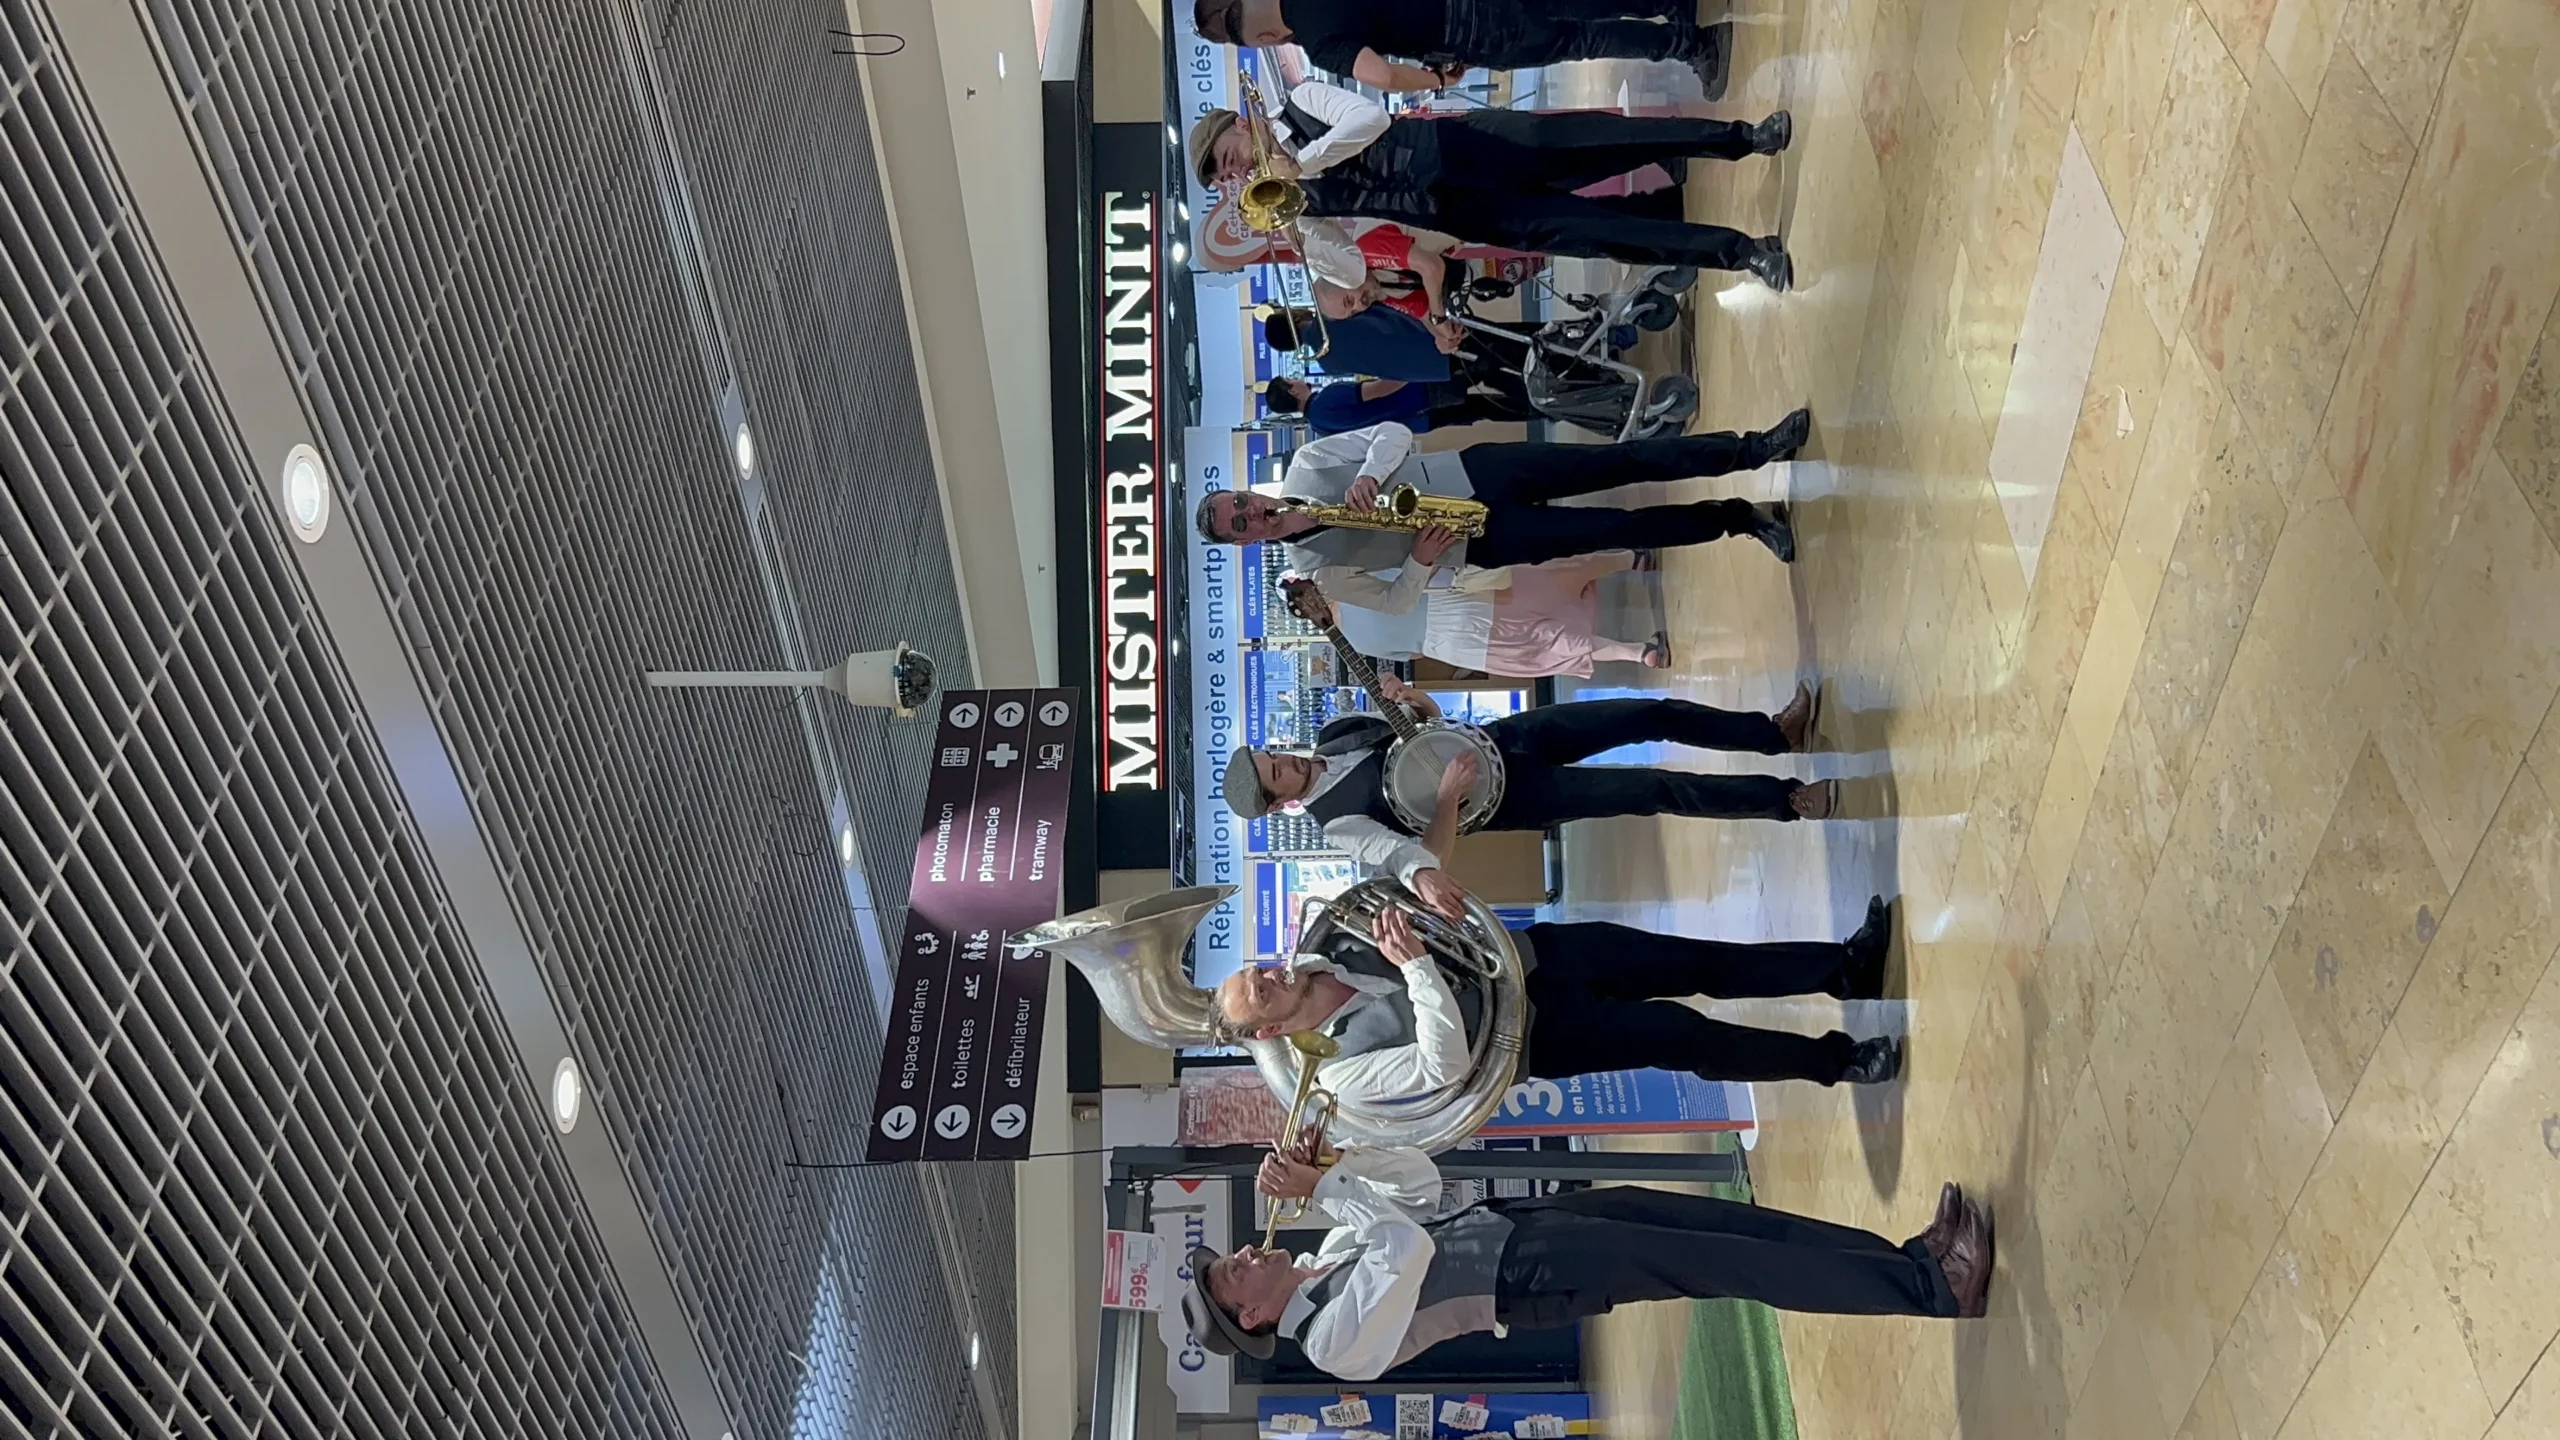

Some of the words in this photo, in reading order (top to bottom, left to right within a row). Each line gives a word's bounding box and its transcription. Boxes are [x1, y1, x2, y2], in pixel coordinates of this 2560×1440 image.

[1190, 44, 1212, 92] clés
[1228, 201, 1238, 235] Cette
[1105, 192, 1152, 442] MINIT
[1258, 342, 1266, 359] PILES
[1201, 465, 1228, 639] smartpes
[1248, 566, 1256, 595] PLATES
[1106, 463, 1157, 792] MISTER
[1247, 597, 1256, 616] CLÉS
[1208, 648, 1225, 664] &
[1248, 656, 1258, 718] ÉLECTRONIQUES
[1249, 720, 1259, 740] CLÉS
[929, 803, 953, 882] photomaton
[977, 806, 1000, 882] pharmacie
[1028, 820, 1052, 881] tramway
[1208, 810, 1234, 950] Répration
[1261, 890, 1270, 926] SÉCURITÉ
[909, 978, 929, 1032] enfants
[900, 1036, 920, 1089] espace
[951, 1019, 975, 1088] toilettes
[1005, 997, 1030, 1088] défibrilateur
[1503, 1076, 1563, 1117] 3
[1572, 1096, 1584, 1114] en
[1594, 1096, 1603, 1114] suite
[1604, 1085, 1613, 1102] votre
[1607, 1104, 1615, 1114] de
[1620, 1104, 1628, 1114] au
